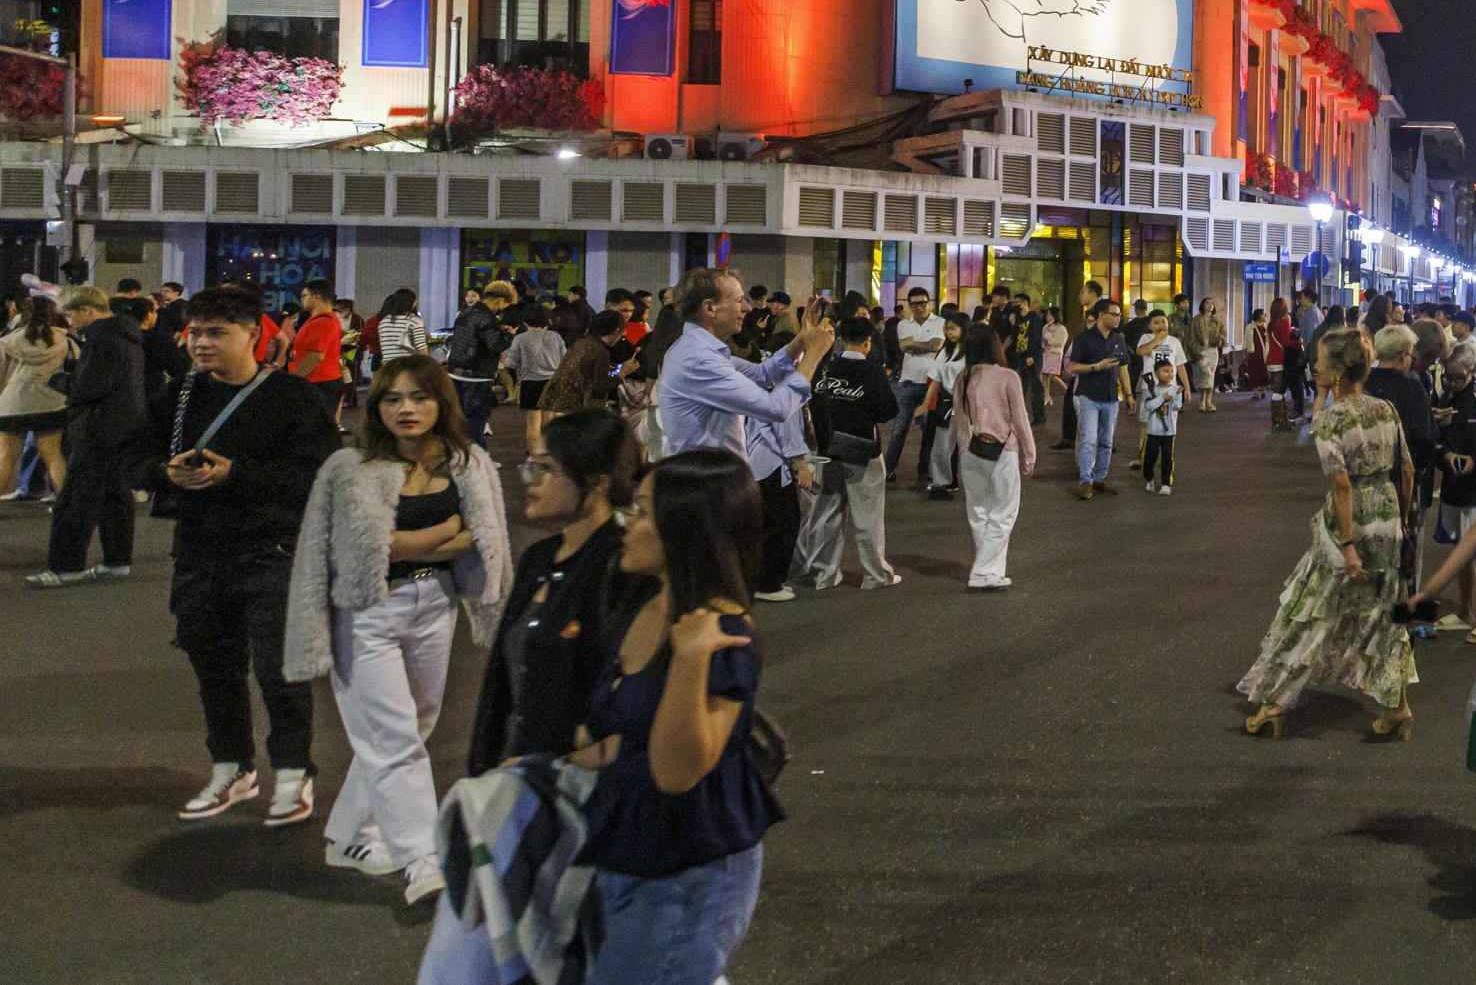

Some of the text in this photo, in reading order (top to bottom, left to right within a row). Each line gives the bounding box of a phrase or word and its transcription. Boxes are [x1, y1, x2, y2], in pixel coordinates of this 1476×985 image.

[1028, 44, 1054, 61] XÂY
[1059, 52, 1095, 68] DỰNG
[1099, 57, 1116, 73] LẠI
[1060, 76, 1105, 94] HOÀNG
